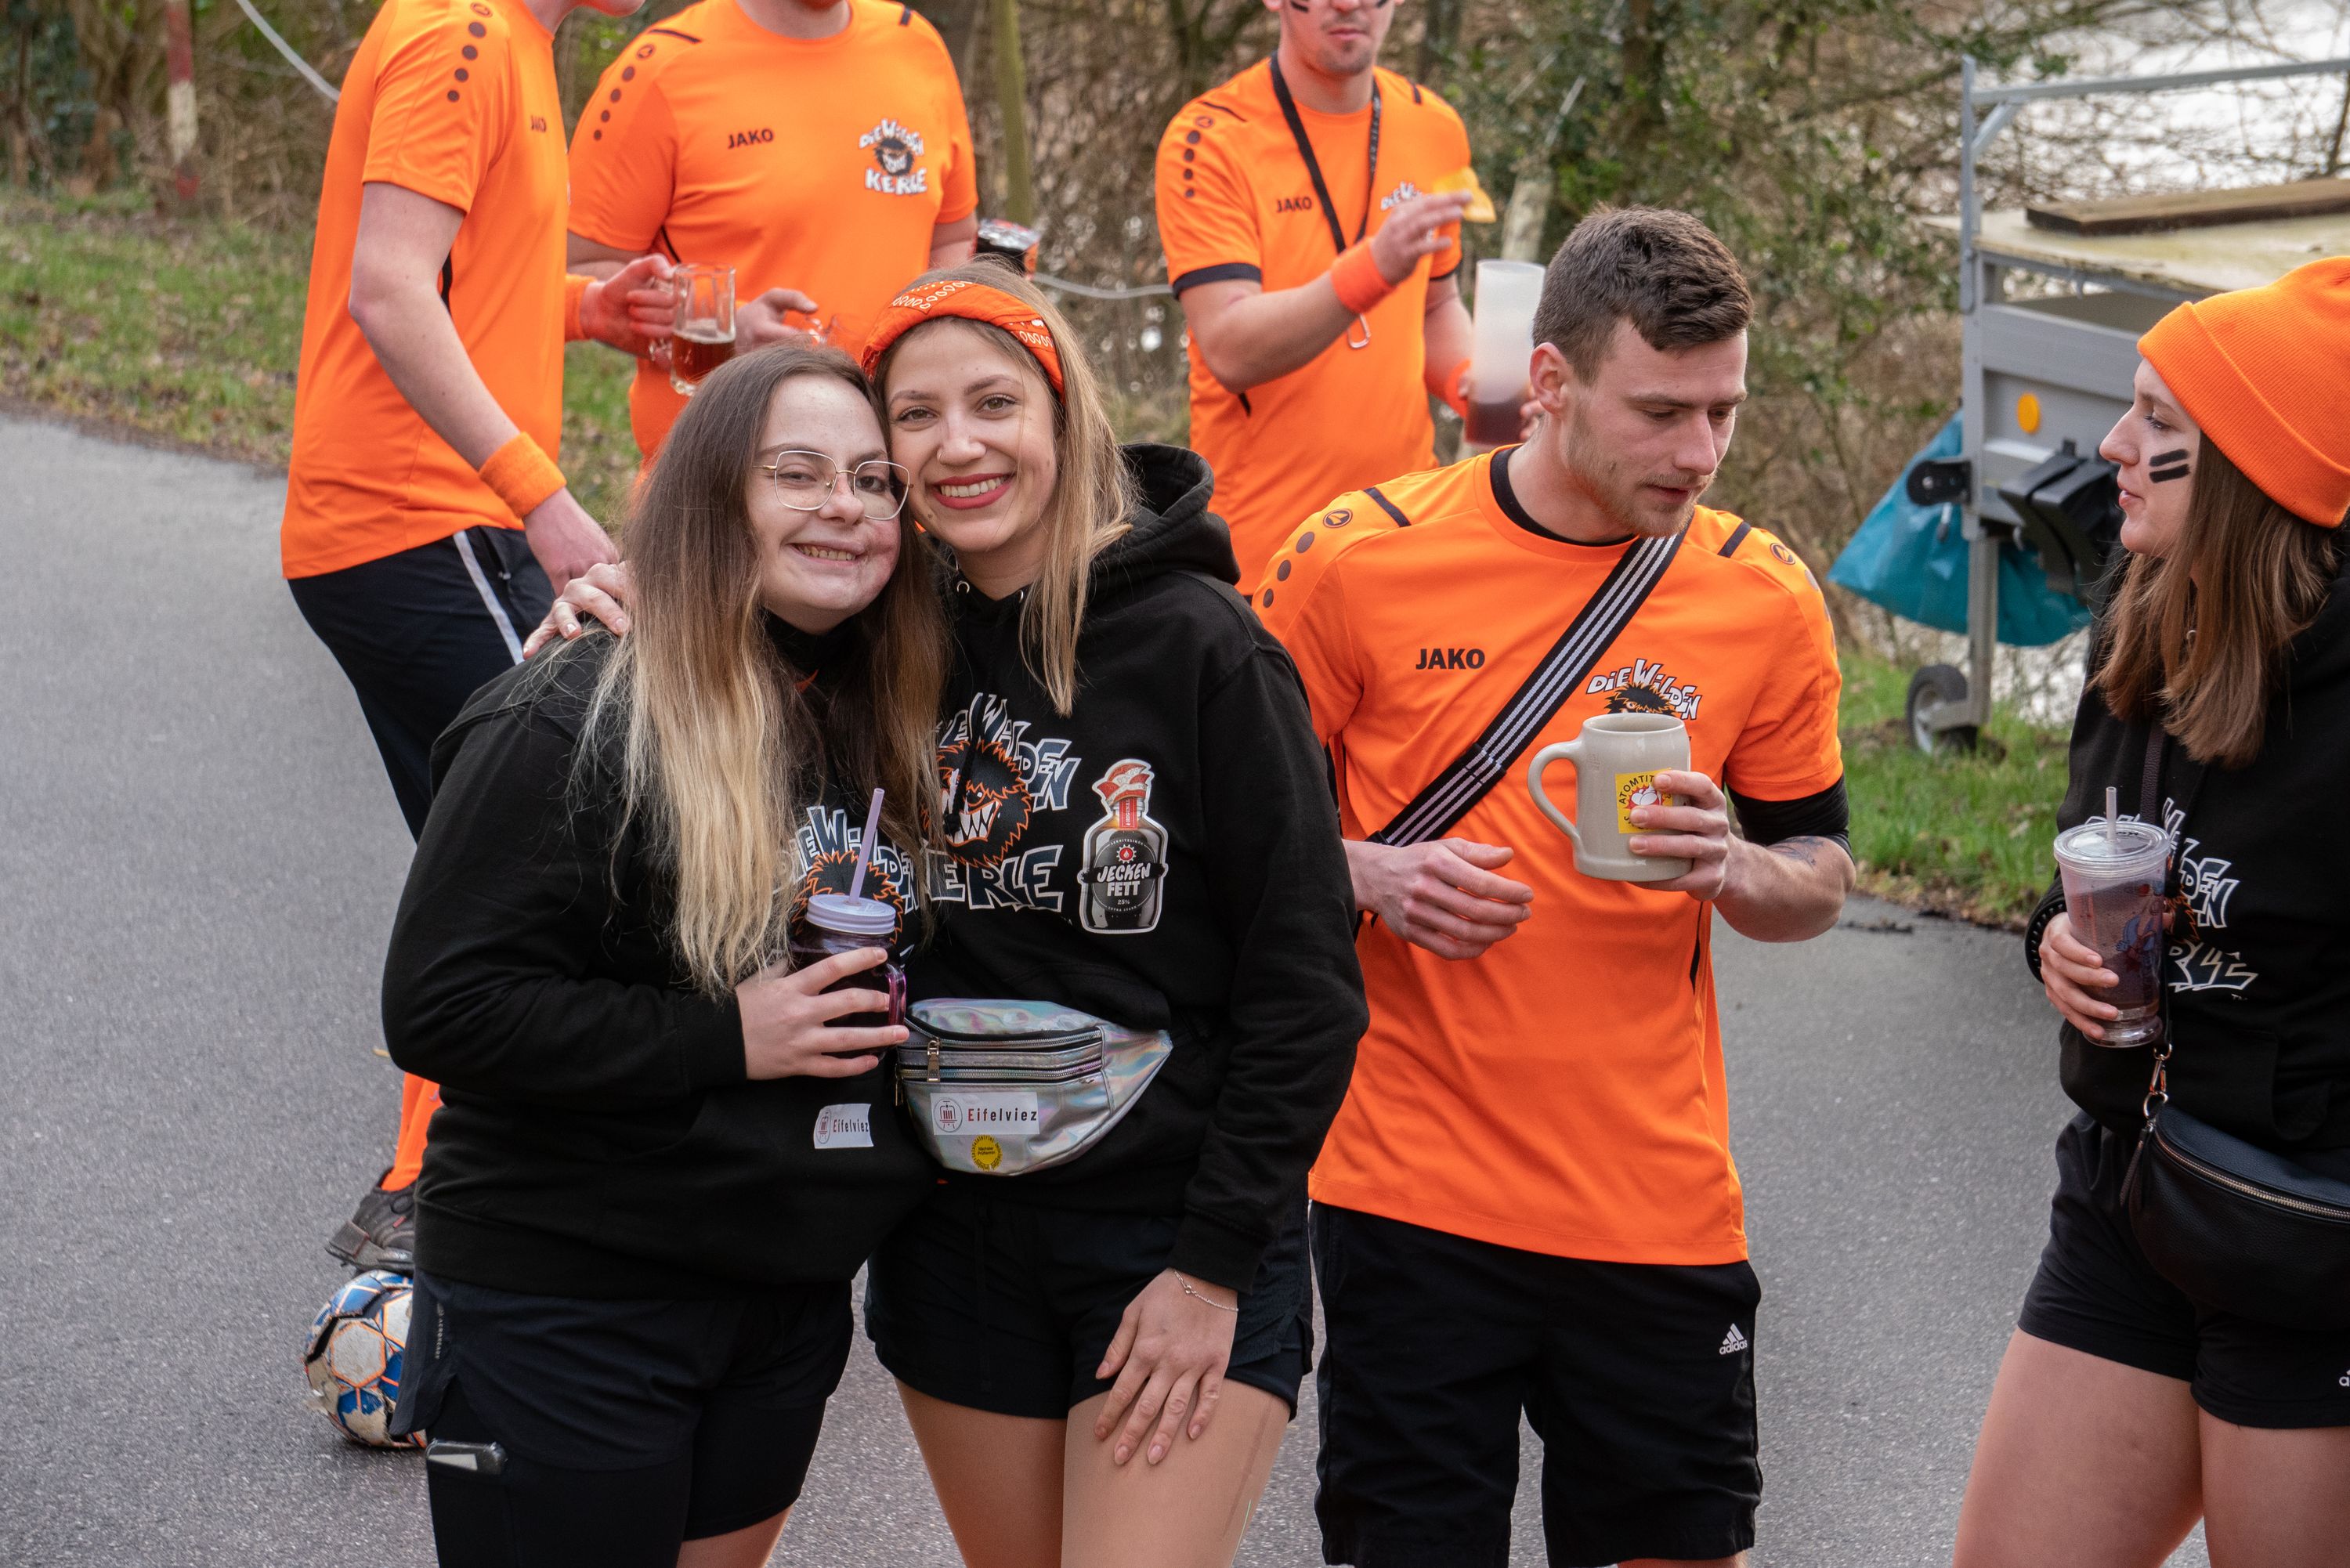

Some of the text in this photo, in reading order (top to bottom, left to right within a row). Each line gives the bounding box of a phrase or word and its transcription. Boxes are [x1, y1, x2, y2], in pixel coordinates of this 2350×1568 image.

[727, 128, 774, 150] JAKO
[865, 167, 928, 196] KERLE
[1276, 197, 1313, 212] JAKO
[1415, 649, 1486, 670] JAKO
[920, 840, 1064, 912] ERLE
[1097, 862, 1152, 883] JECKEN
[1107, 880, 1141, 897] FETT
[967, 1107, 1037, 1122] Eifelviez
[833, 1118, 870, 1133] Eifelviez
[1719, 1339, 1748, 1355] adidas
